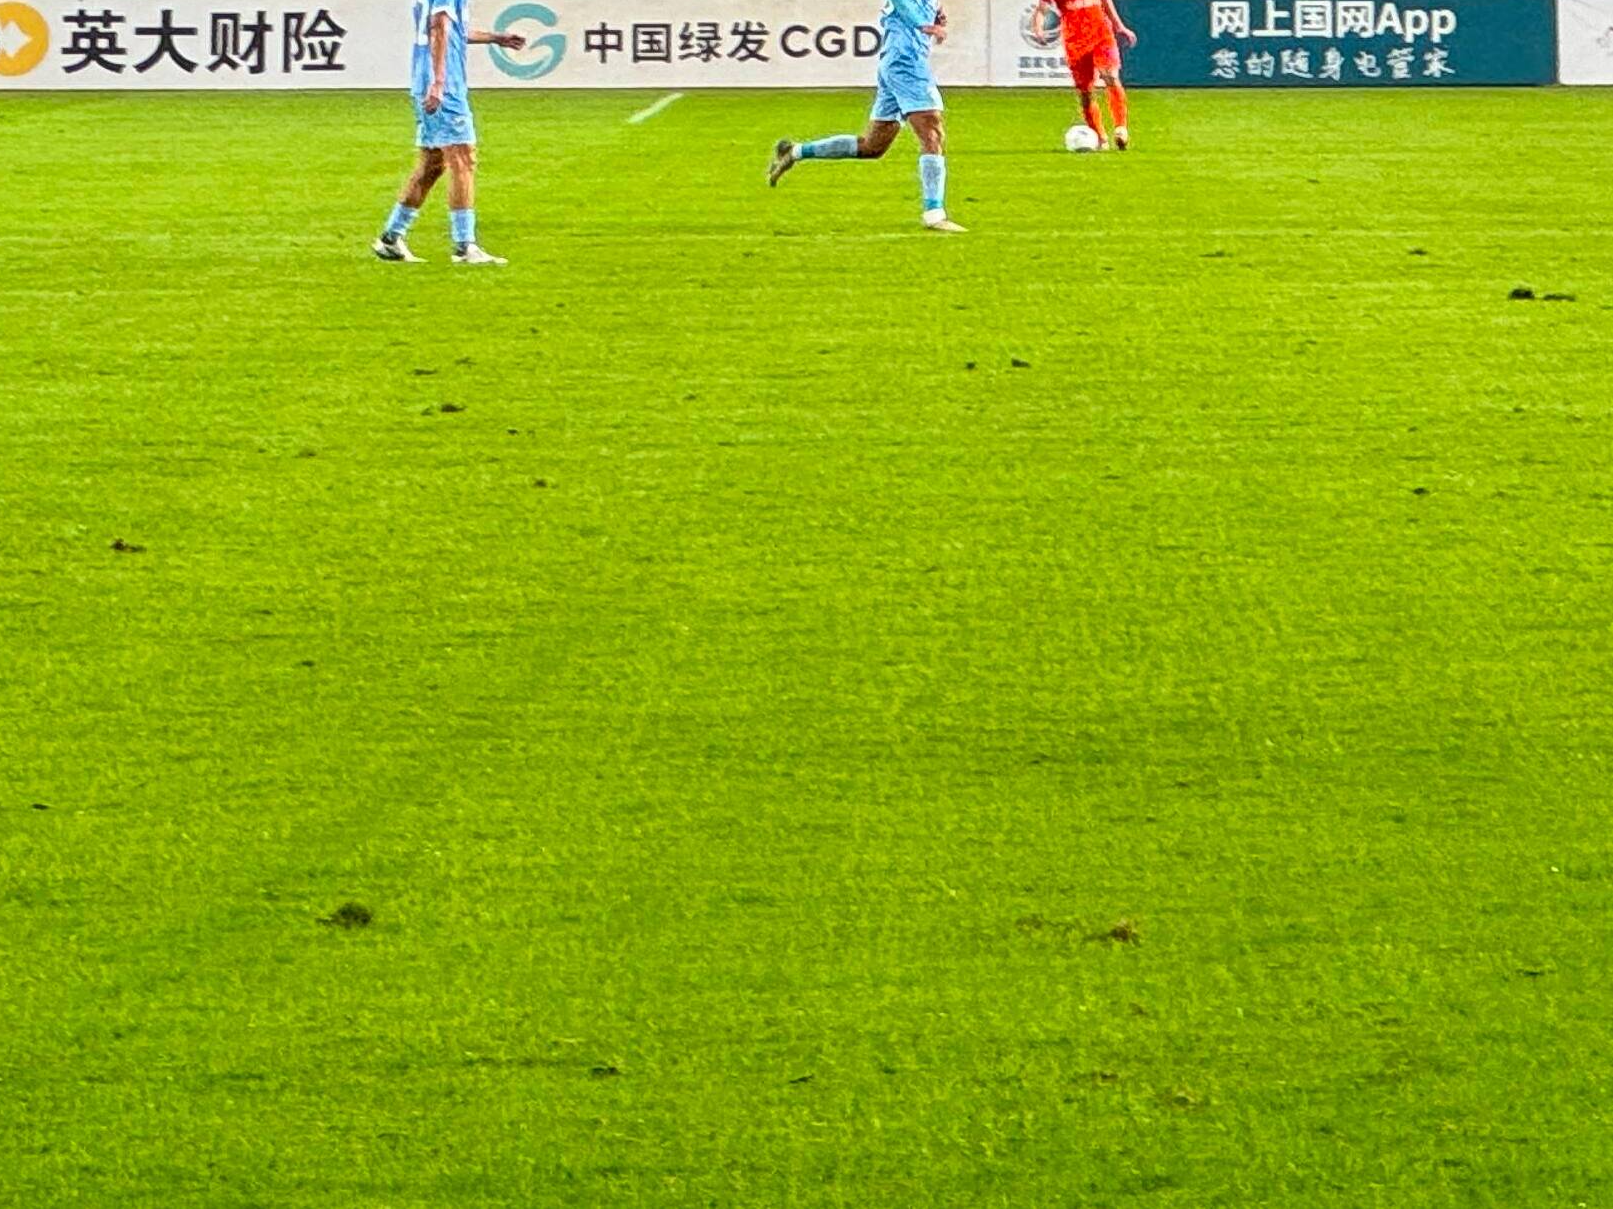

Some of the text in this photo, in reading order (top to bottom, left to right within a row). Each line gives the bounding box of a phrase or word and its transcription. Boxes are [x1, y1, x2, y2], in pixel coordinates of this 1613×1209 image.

[61, 9, 348, 75] 英大财险
[584, 21, 771, 64] 中国绿发
[1210, 0, 1457, 43] 网上国网App
